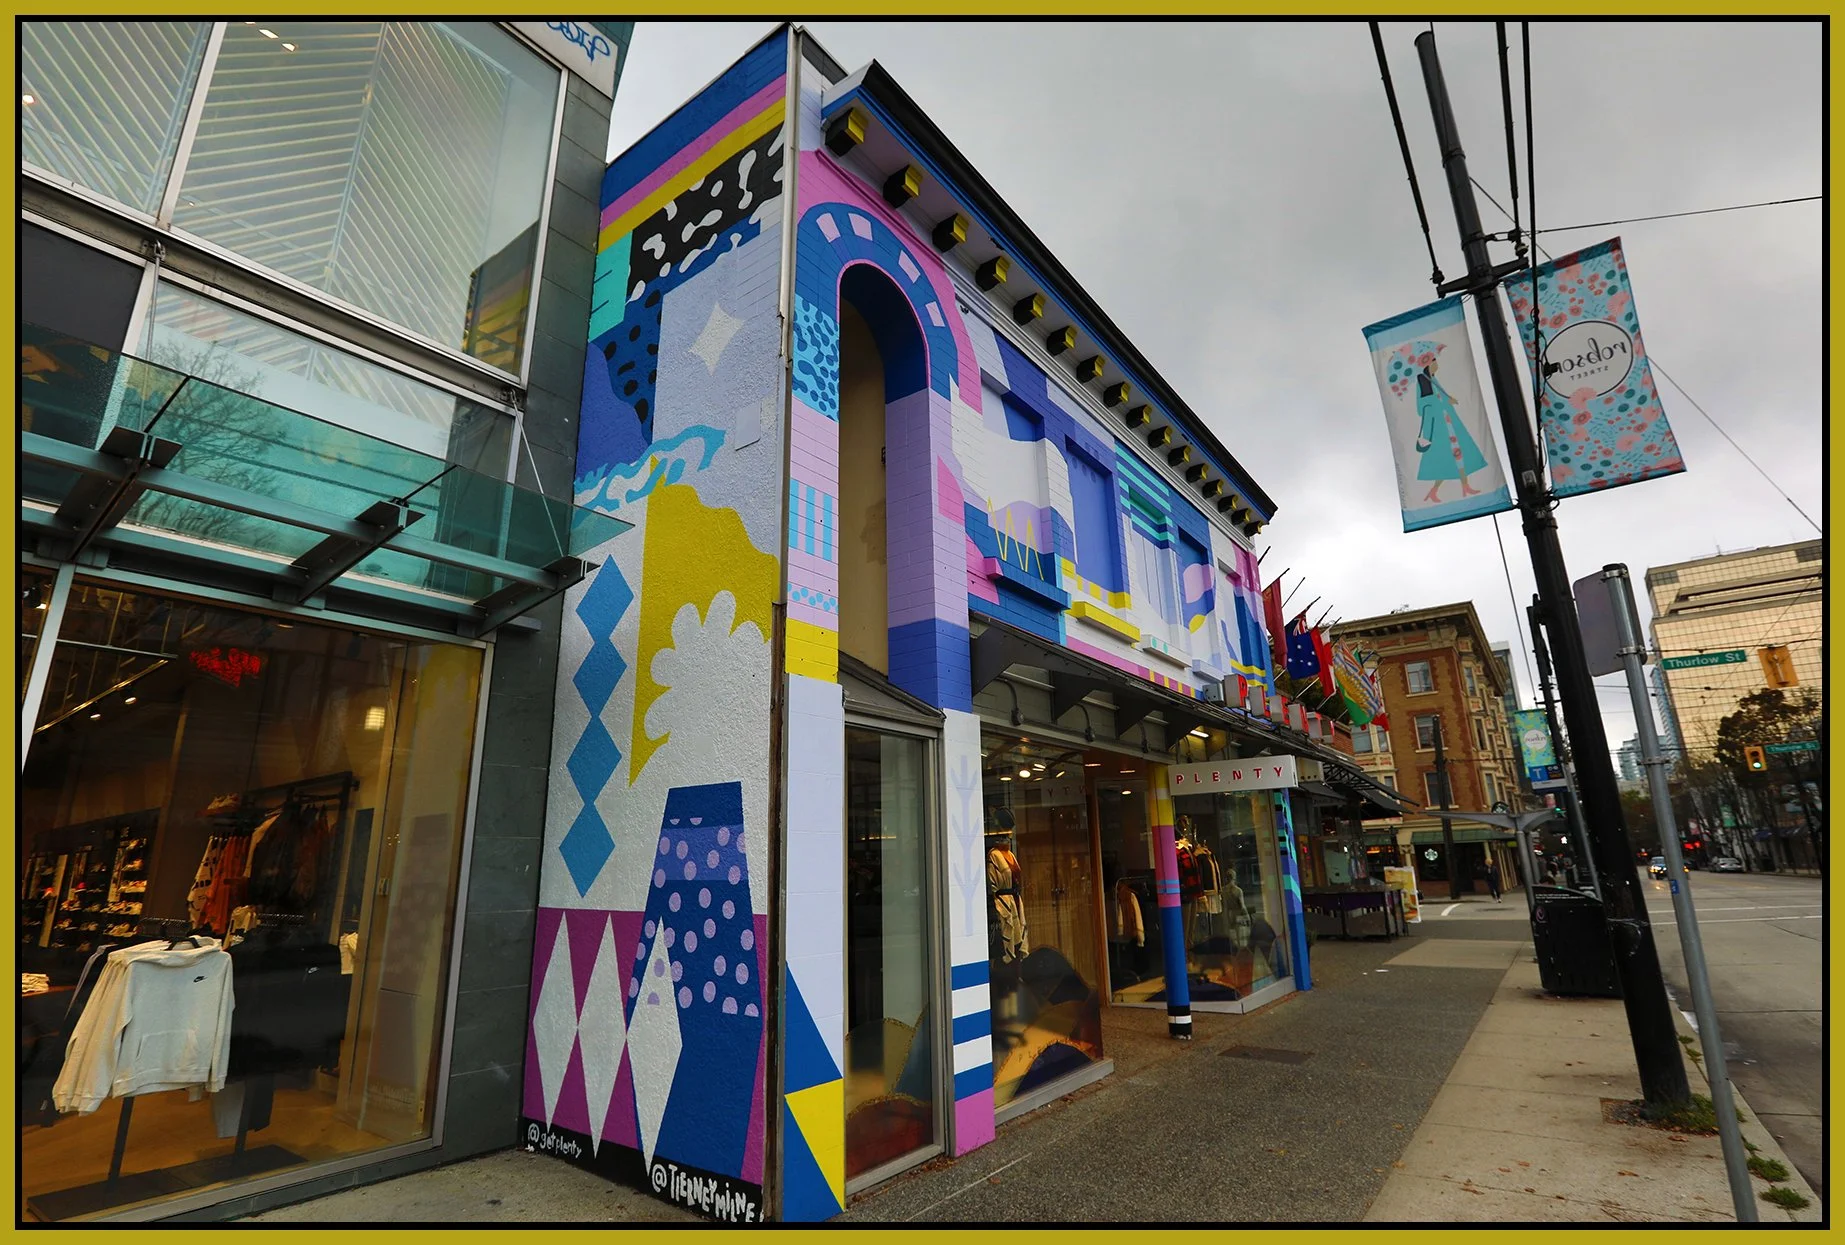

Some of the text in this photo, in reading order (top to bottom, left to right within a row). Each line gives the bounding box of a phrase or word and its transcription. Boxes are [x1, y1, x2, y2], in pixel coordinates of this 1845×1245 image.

[1668, 652, 1741, 668] Thurlow St
[1224, 673, 1335, 744] PLEN
[1175, 766, 1284, 785] PLENTY
